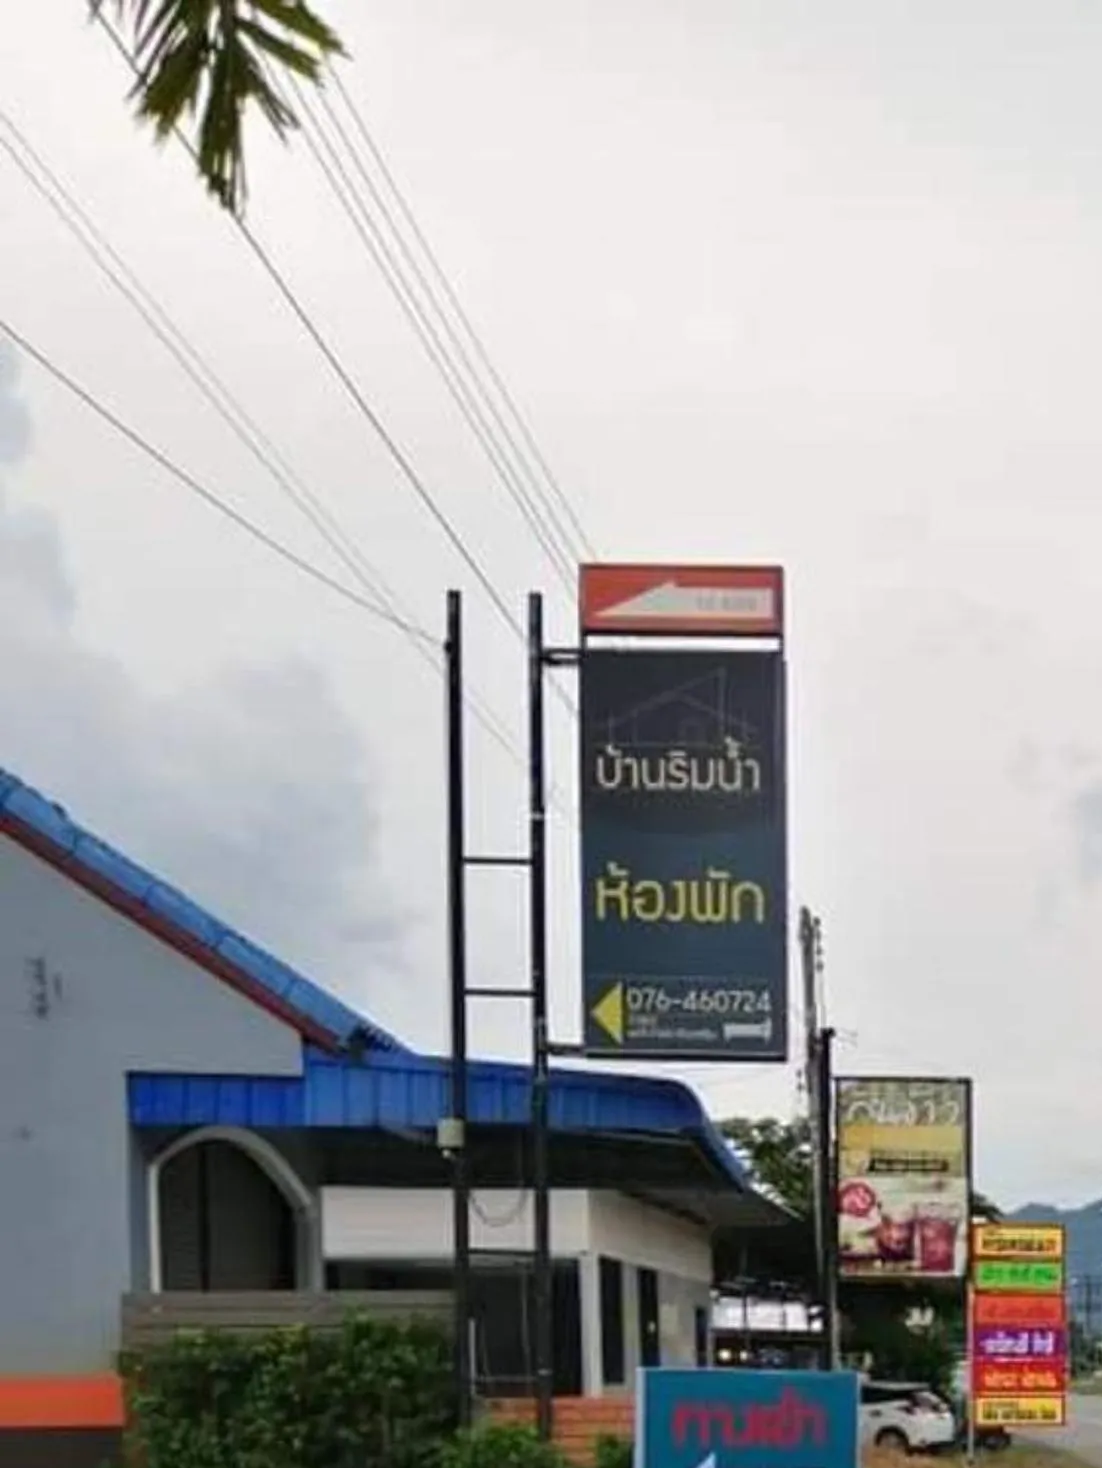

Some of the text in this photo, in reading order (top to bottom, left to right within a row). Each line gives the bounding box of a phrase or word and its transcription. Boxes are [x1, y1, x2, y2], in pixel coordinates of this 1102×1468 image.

[595, 861, 765, 925] ห้องพัก
[626, 987, 772, 1014] 076-460724
